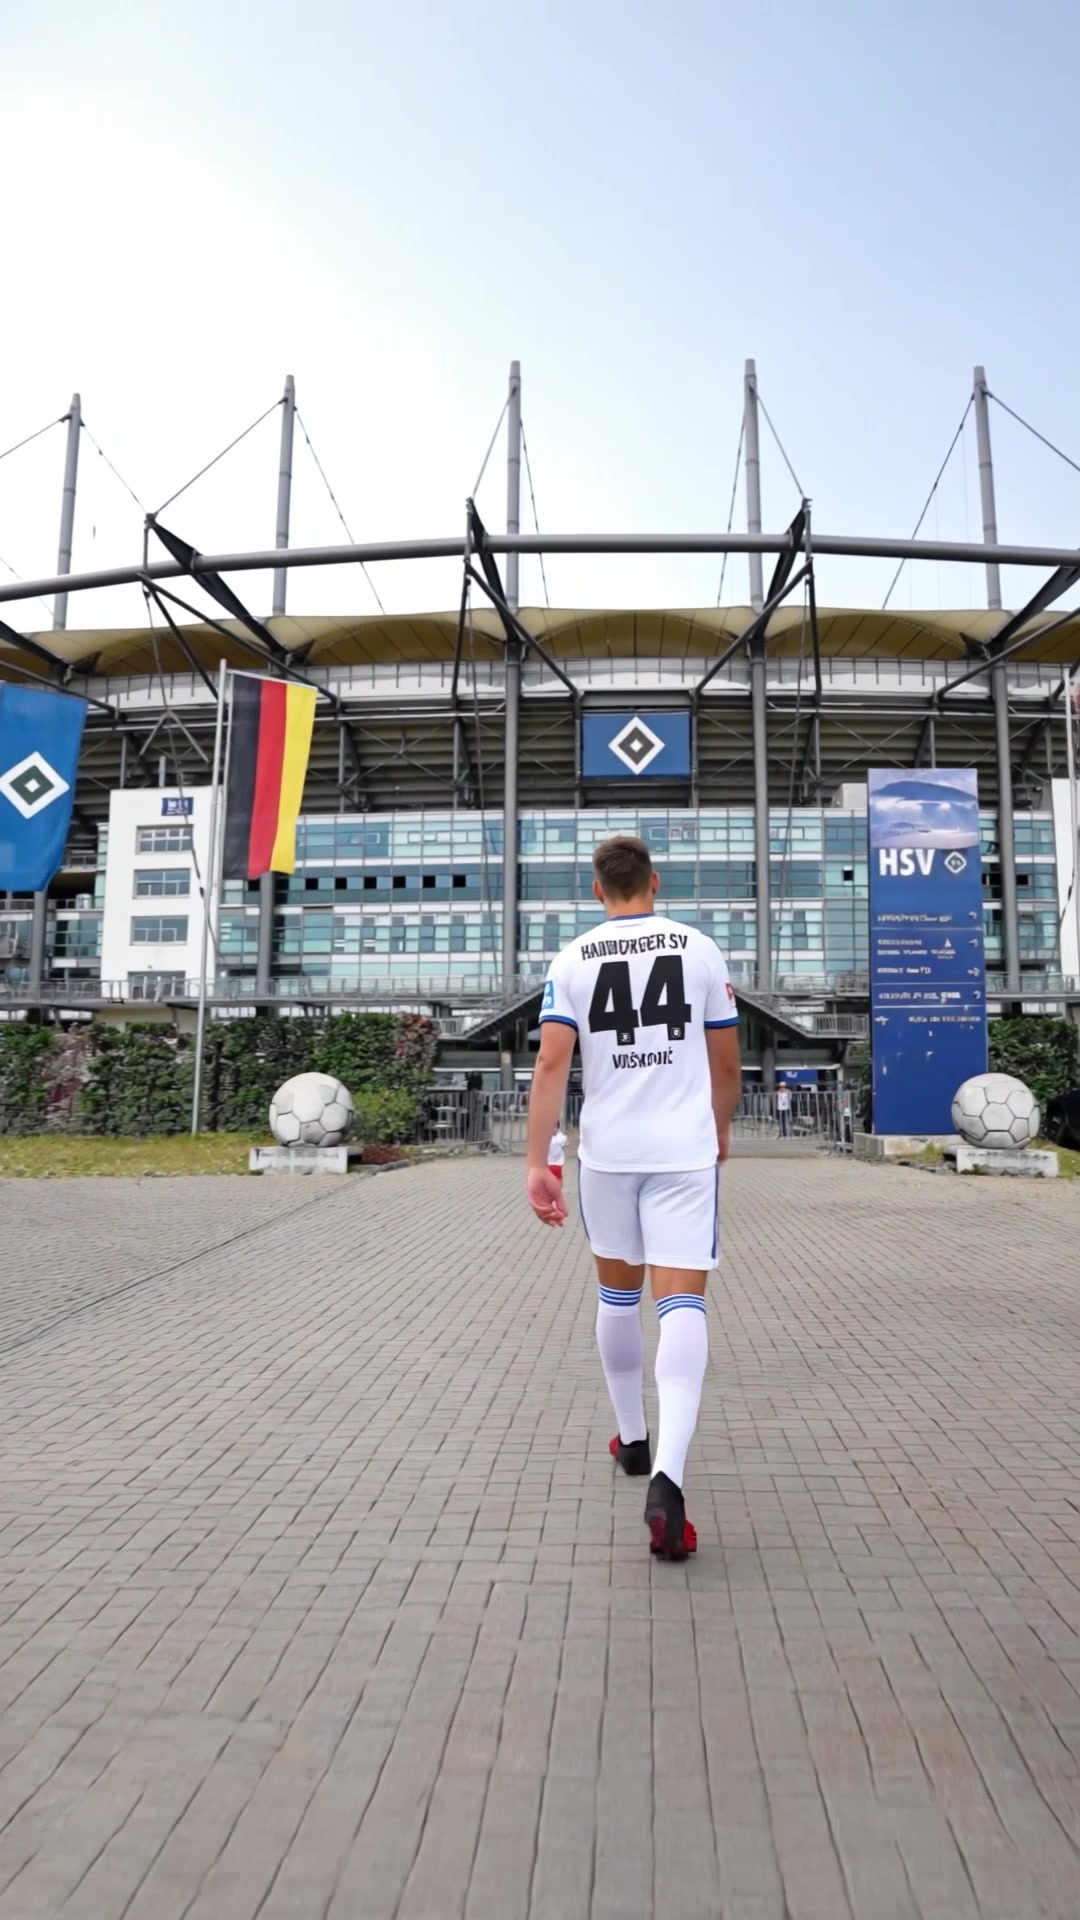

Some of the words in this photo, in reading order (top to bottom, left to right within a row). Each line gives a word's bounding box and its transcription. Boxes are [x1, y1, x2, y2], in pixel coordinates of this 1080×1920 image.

[879, 848, 935, 876] HSV
[669, 933, 688, 949] SV
[588, 955, 692, 1046] 44
